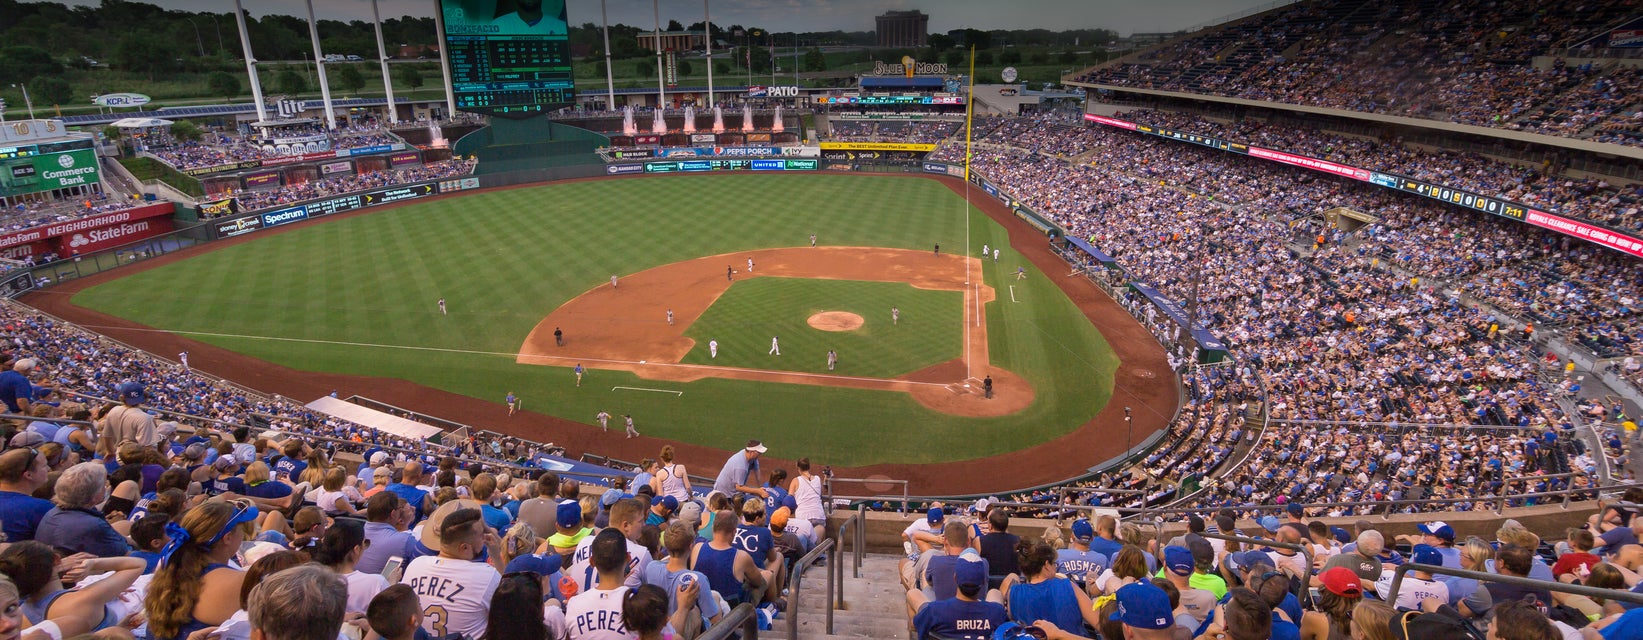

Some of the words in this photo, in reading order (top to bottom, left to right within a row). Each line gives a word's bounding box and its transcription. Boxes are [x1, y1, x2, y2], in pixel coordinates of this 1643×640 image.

[448, 24, 500, 33] BONIFACIO
[768, 86, 798, 96] PATIO
[277, 100, 305, 118] Lite
[13, 122, 30, 135] 10
[45, 120, 56, 132] 5
[42, 166, 95, 179] Commerce
[59, 175, 85, 186] Bank
[1417, 184, 1424, 193] 4
[1432, 188, 1439, 197] B
[1442, 190, 1449, 199] 0
[1453, 192, 1460, 202] S
[1465, 196, 1472, 205] 0
[1489, 202, 1496, 211] 0
[1506, 206, 1522, 217] 7:11
[203, 204, 229, 214] SONIC
[265, 209, 304, 224] Spectrum
[47, 212, 130, 236] NEIGHBORHOOD
[1529, 213, 1548, 224] ROYALS
[1548, 218, 1577, 232] CLEARANCE
[1577, 226, 1590, 236] SALE
[1590, 230, 1608, 241] GOING
[89, 221, 149, 244] StateFarm
[4, 245, 32, 258] arm
[732, 528, 759, 552] KC
[1064, 560, 1102, 574] HOSMER
[411, 576, 465, 603] PEREZ
[423, 604, 448, 638] 3
[576, 610, 626, 635] PEREZ
[956, 619, 990, 630] BRUZA
